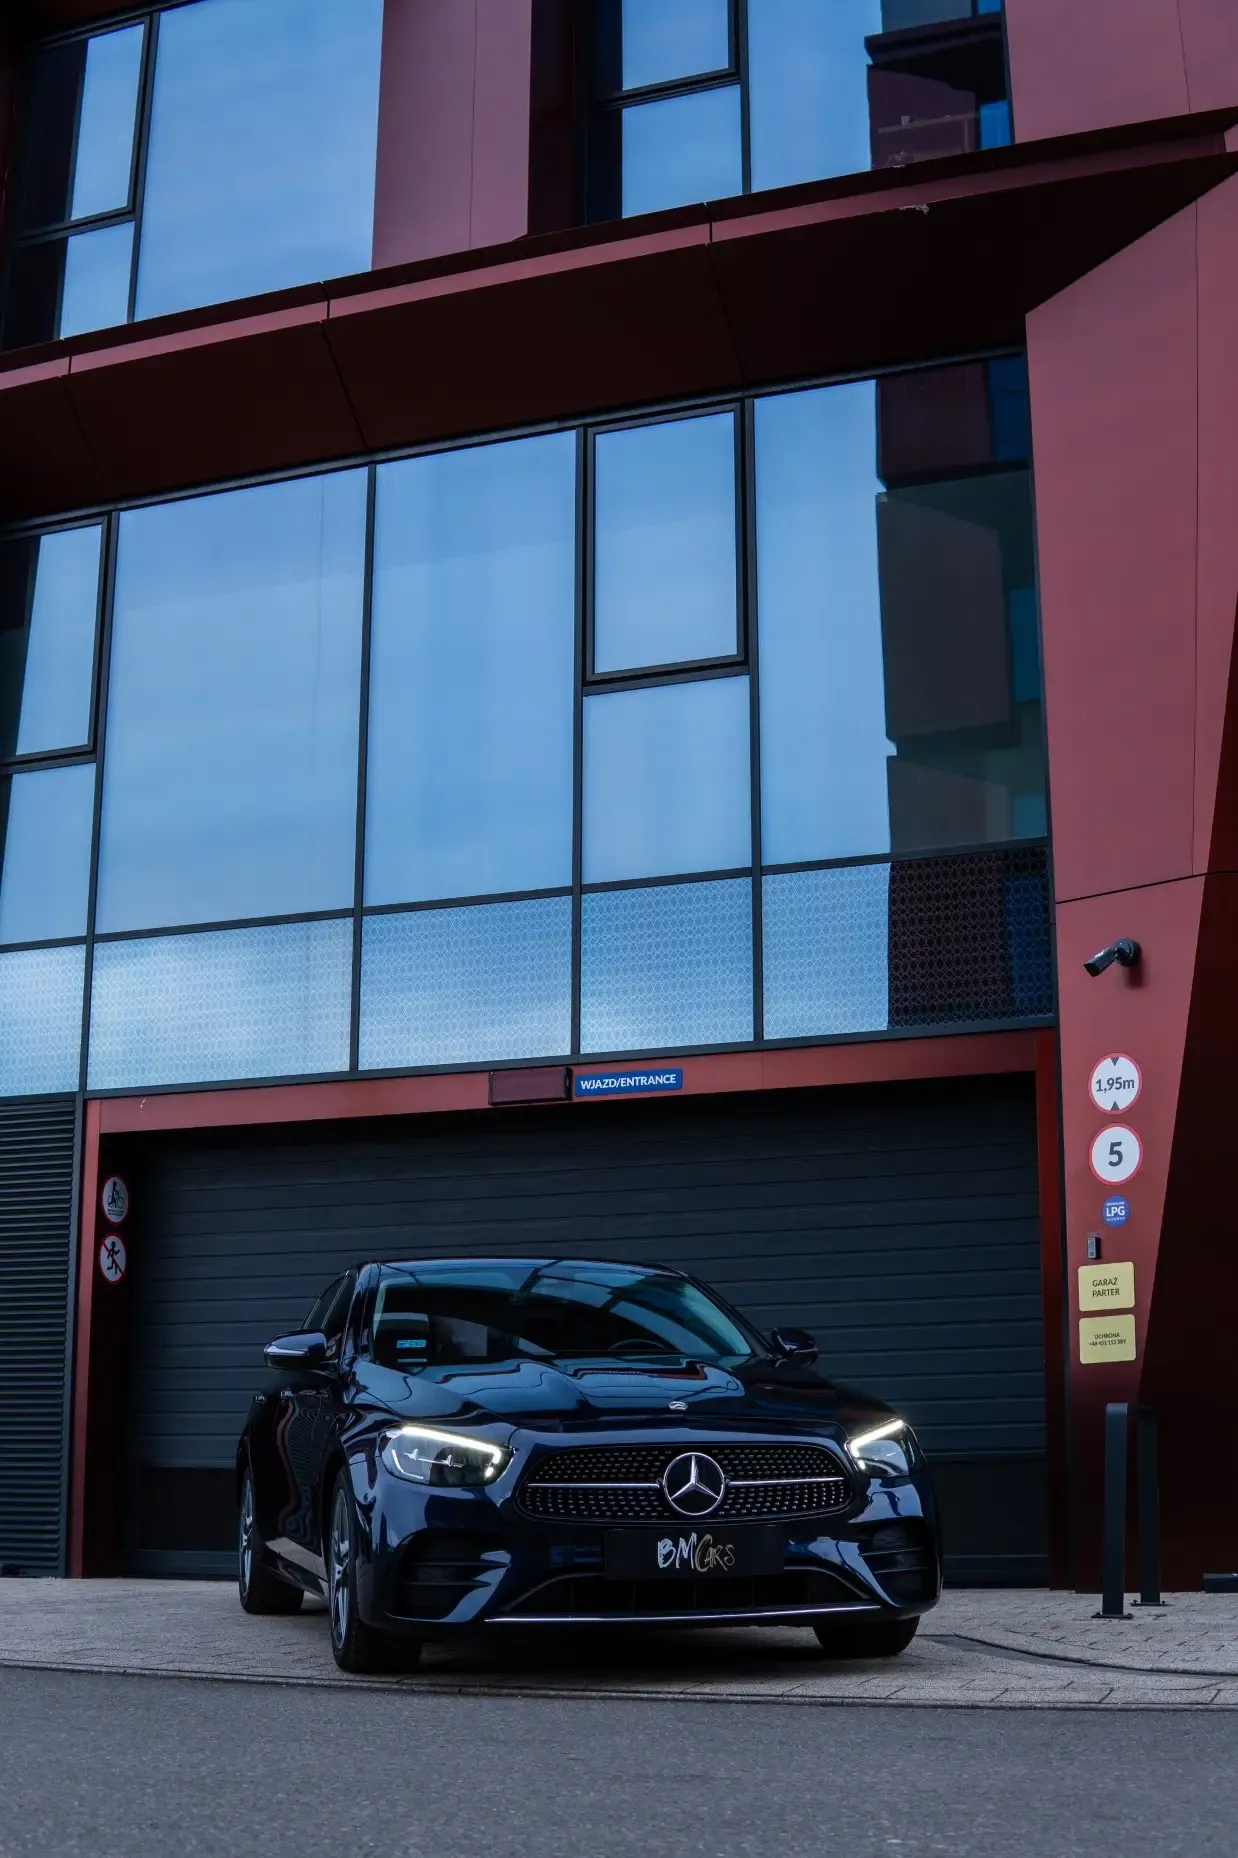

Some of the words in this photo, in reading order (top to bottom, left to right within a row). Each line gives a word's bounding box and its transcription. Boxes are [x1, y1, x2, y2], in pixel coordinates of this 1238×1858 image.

[580, 1074, 677, 1090] WJAZD/ENTRANCE
[1095, 1077, 1135, 1093] 1,95m
[1108, 1141, 1123, 1167] 5
[1106, 1206, 1126, 1217] LPG
[1092, 1288, 1120, 1297] PARTER
